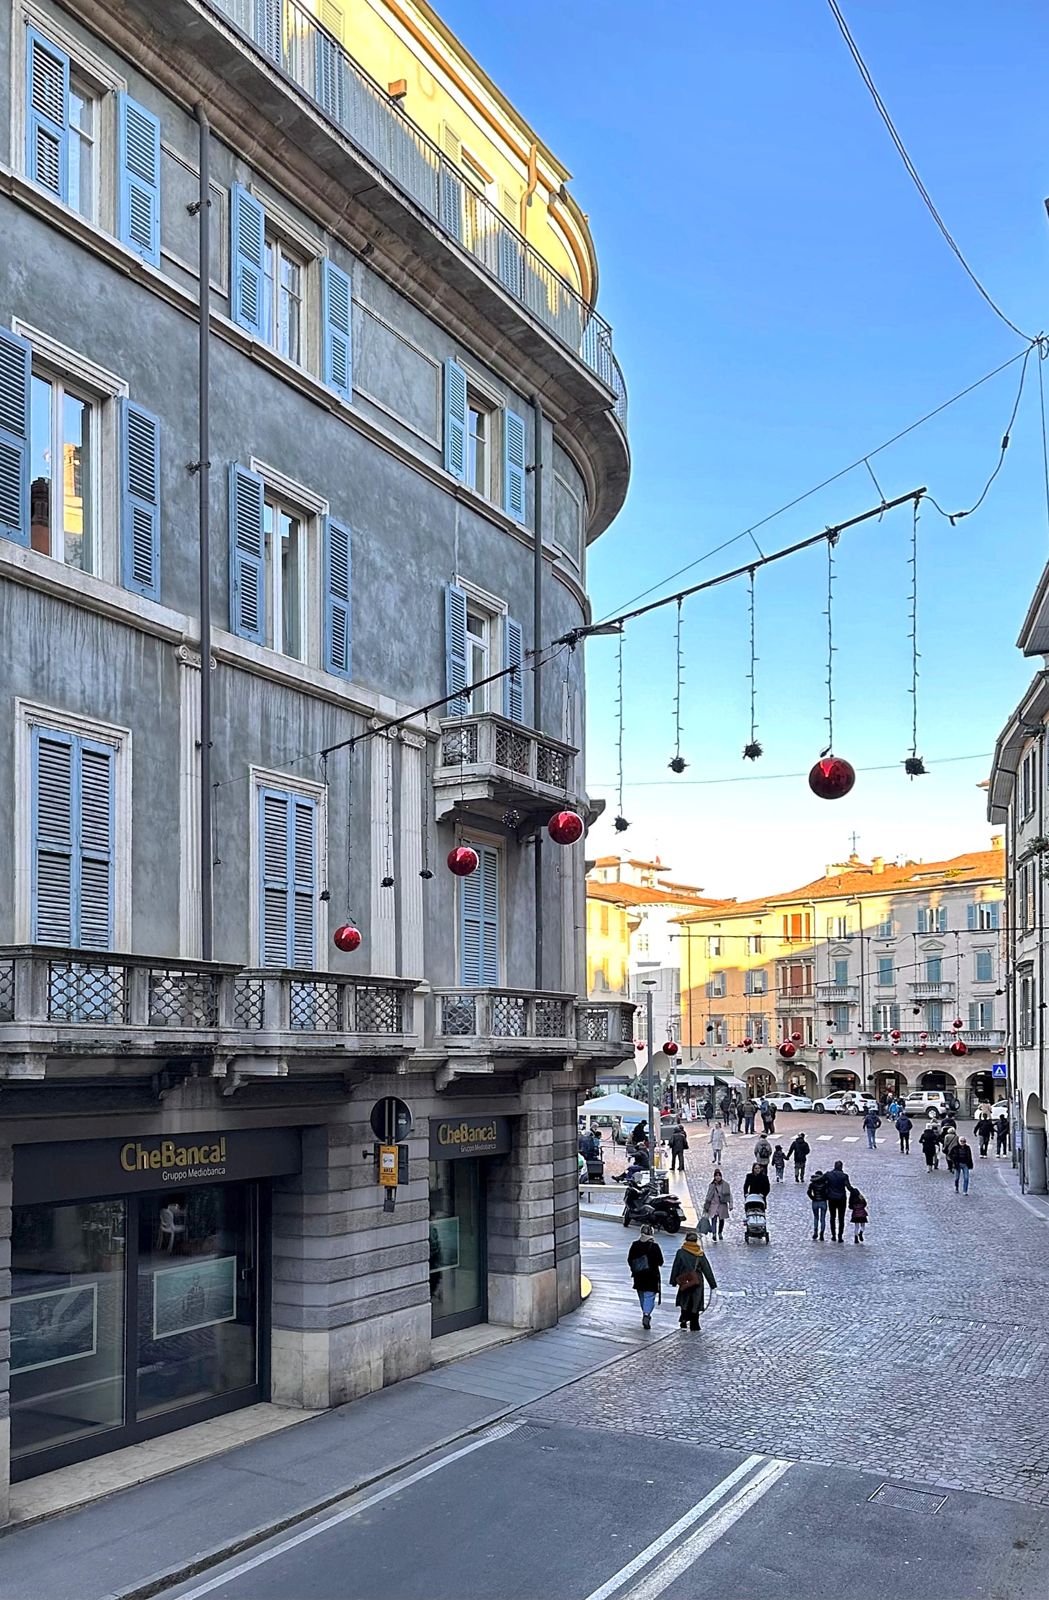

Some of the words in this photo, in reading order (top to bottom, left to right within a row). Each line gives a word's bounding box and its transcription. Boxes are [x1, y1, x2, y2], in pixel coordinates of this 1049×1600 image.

[438, 1121, 497, 1144] CheBanca!
[121, 1137, 225, 1171] CheBanca!
[162, 1171, 187, 1181] Gruppo
[188, 1167, 226, 1178] Mediobanca
